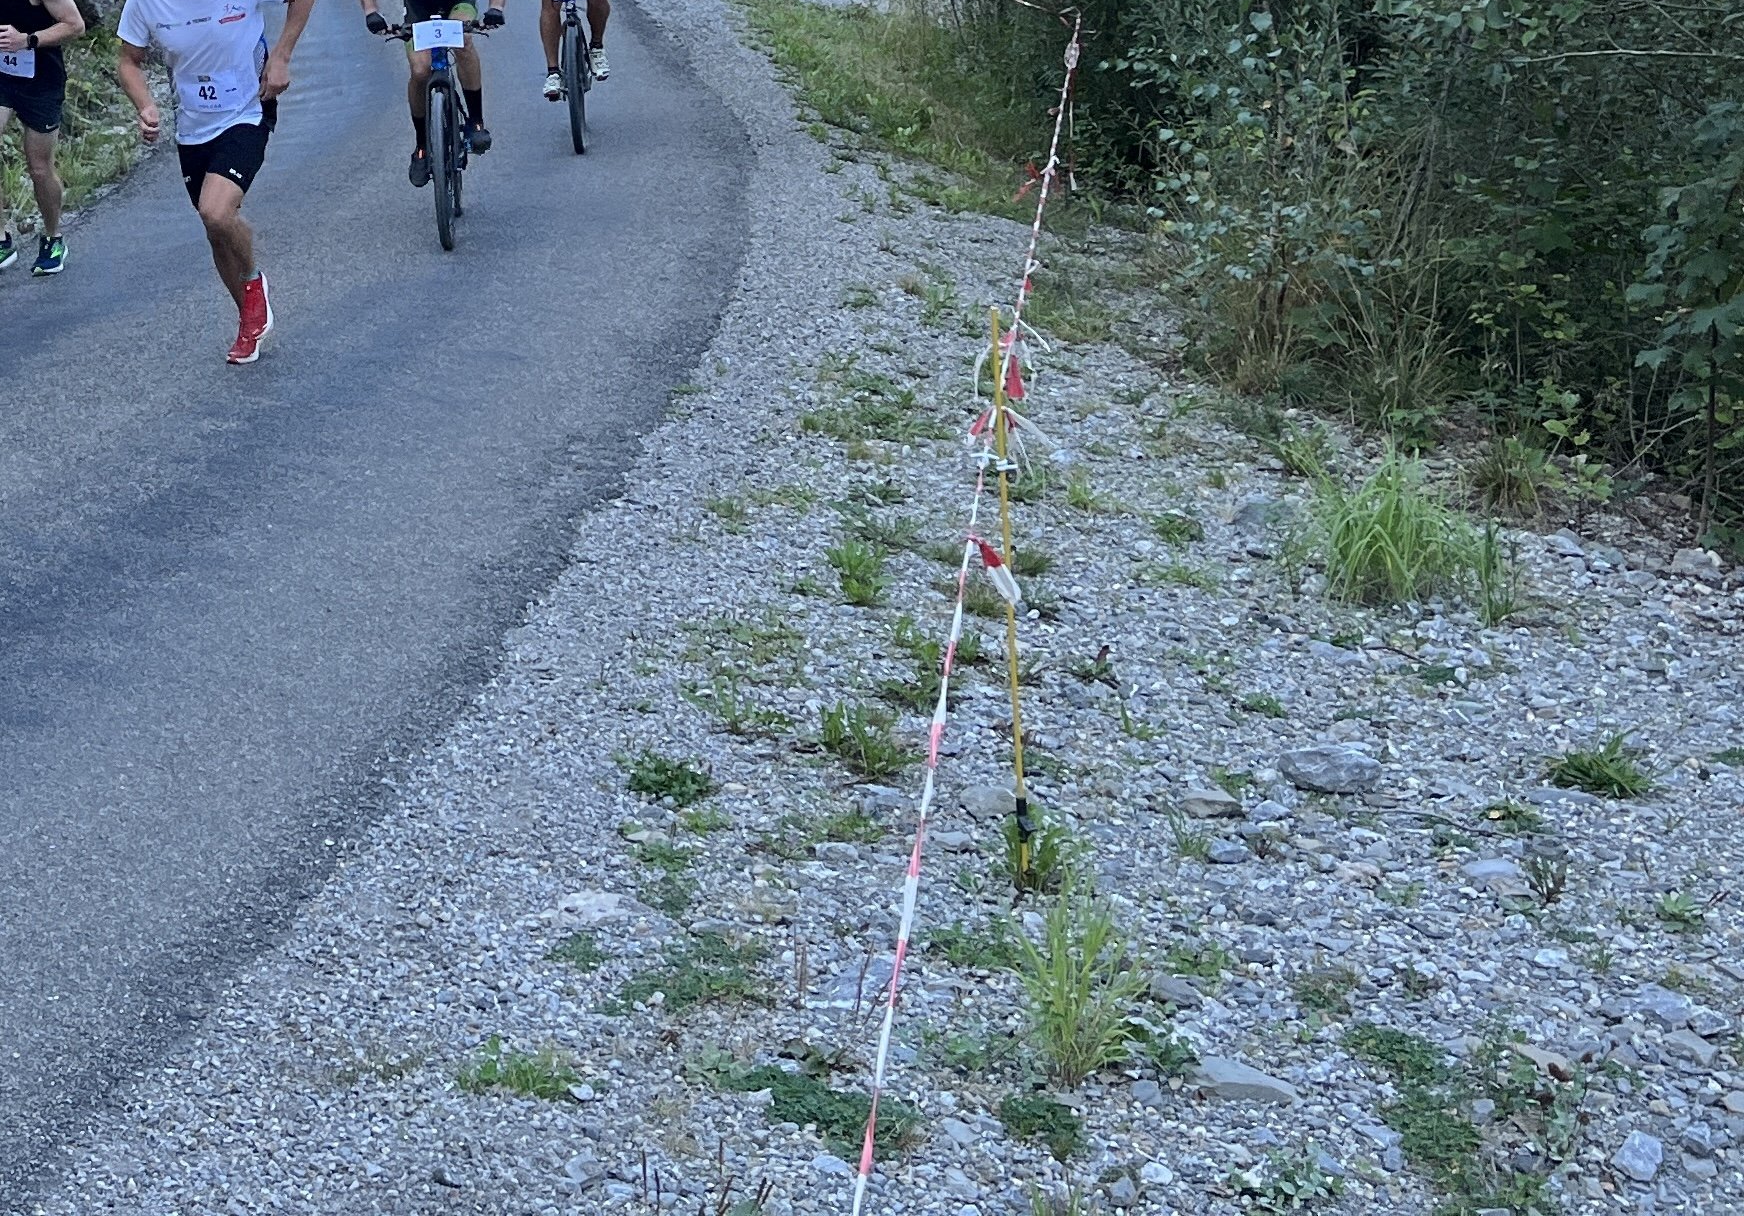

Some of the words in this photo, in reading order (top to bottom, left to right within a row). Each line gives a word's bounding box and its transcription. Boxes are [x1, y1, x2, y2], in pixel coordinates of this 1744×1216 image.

[434, 28, 442, 39] 3
[2, 54, 18, 67] 44
[198, 85, 218, 100] 42
